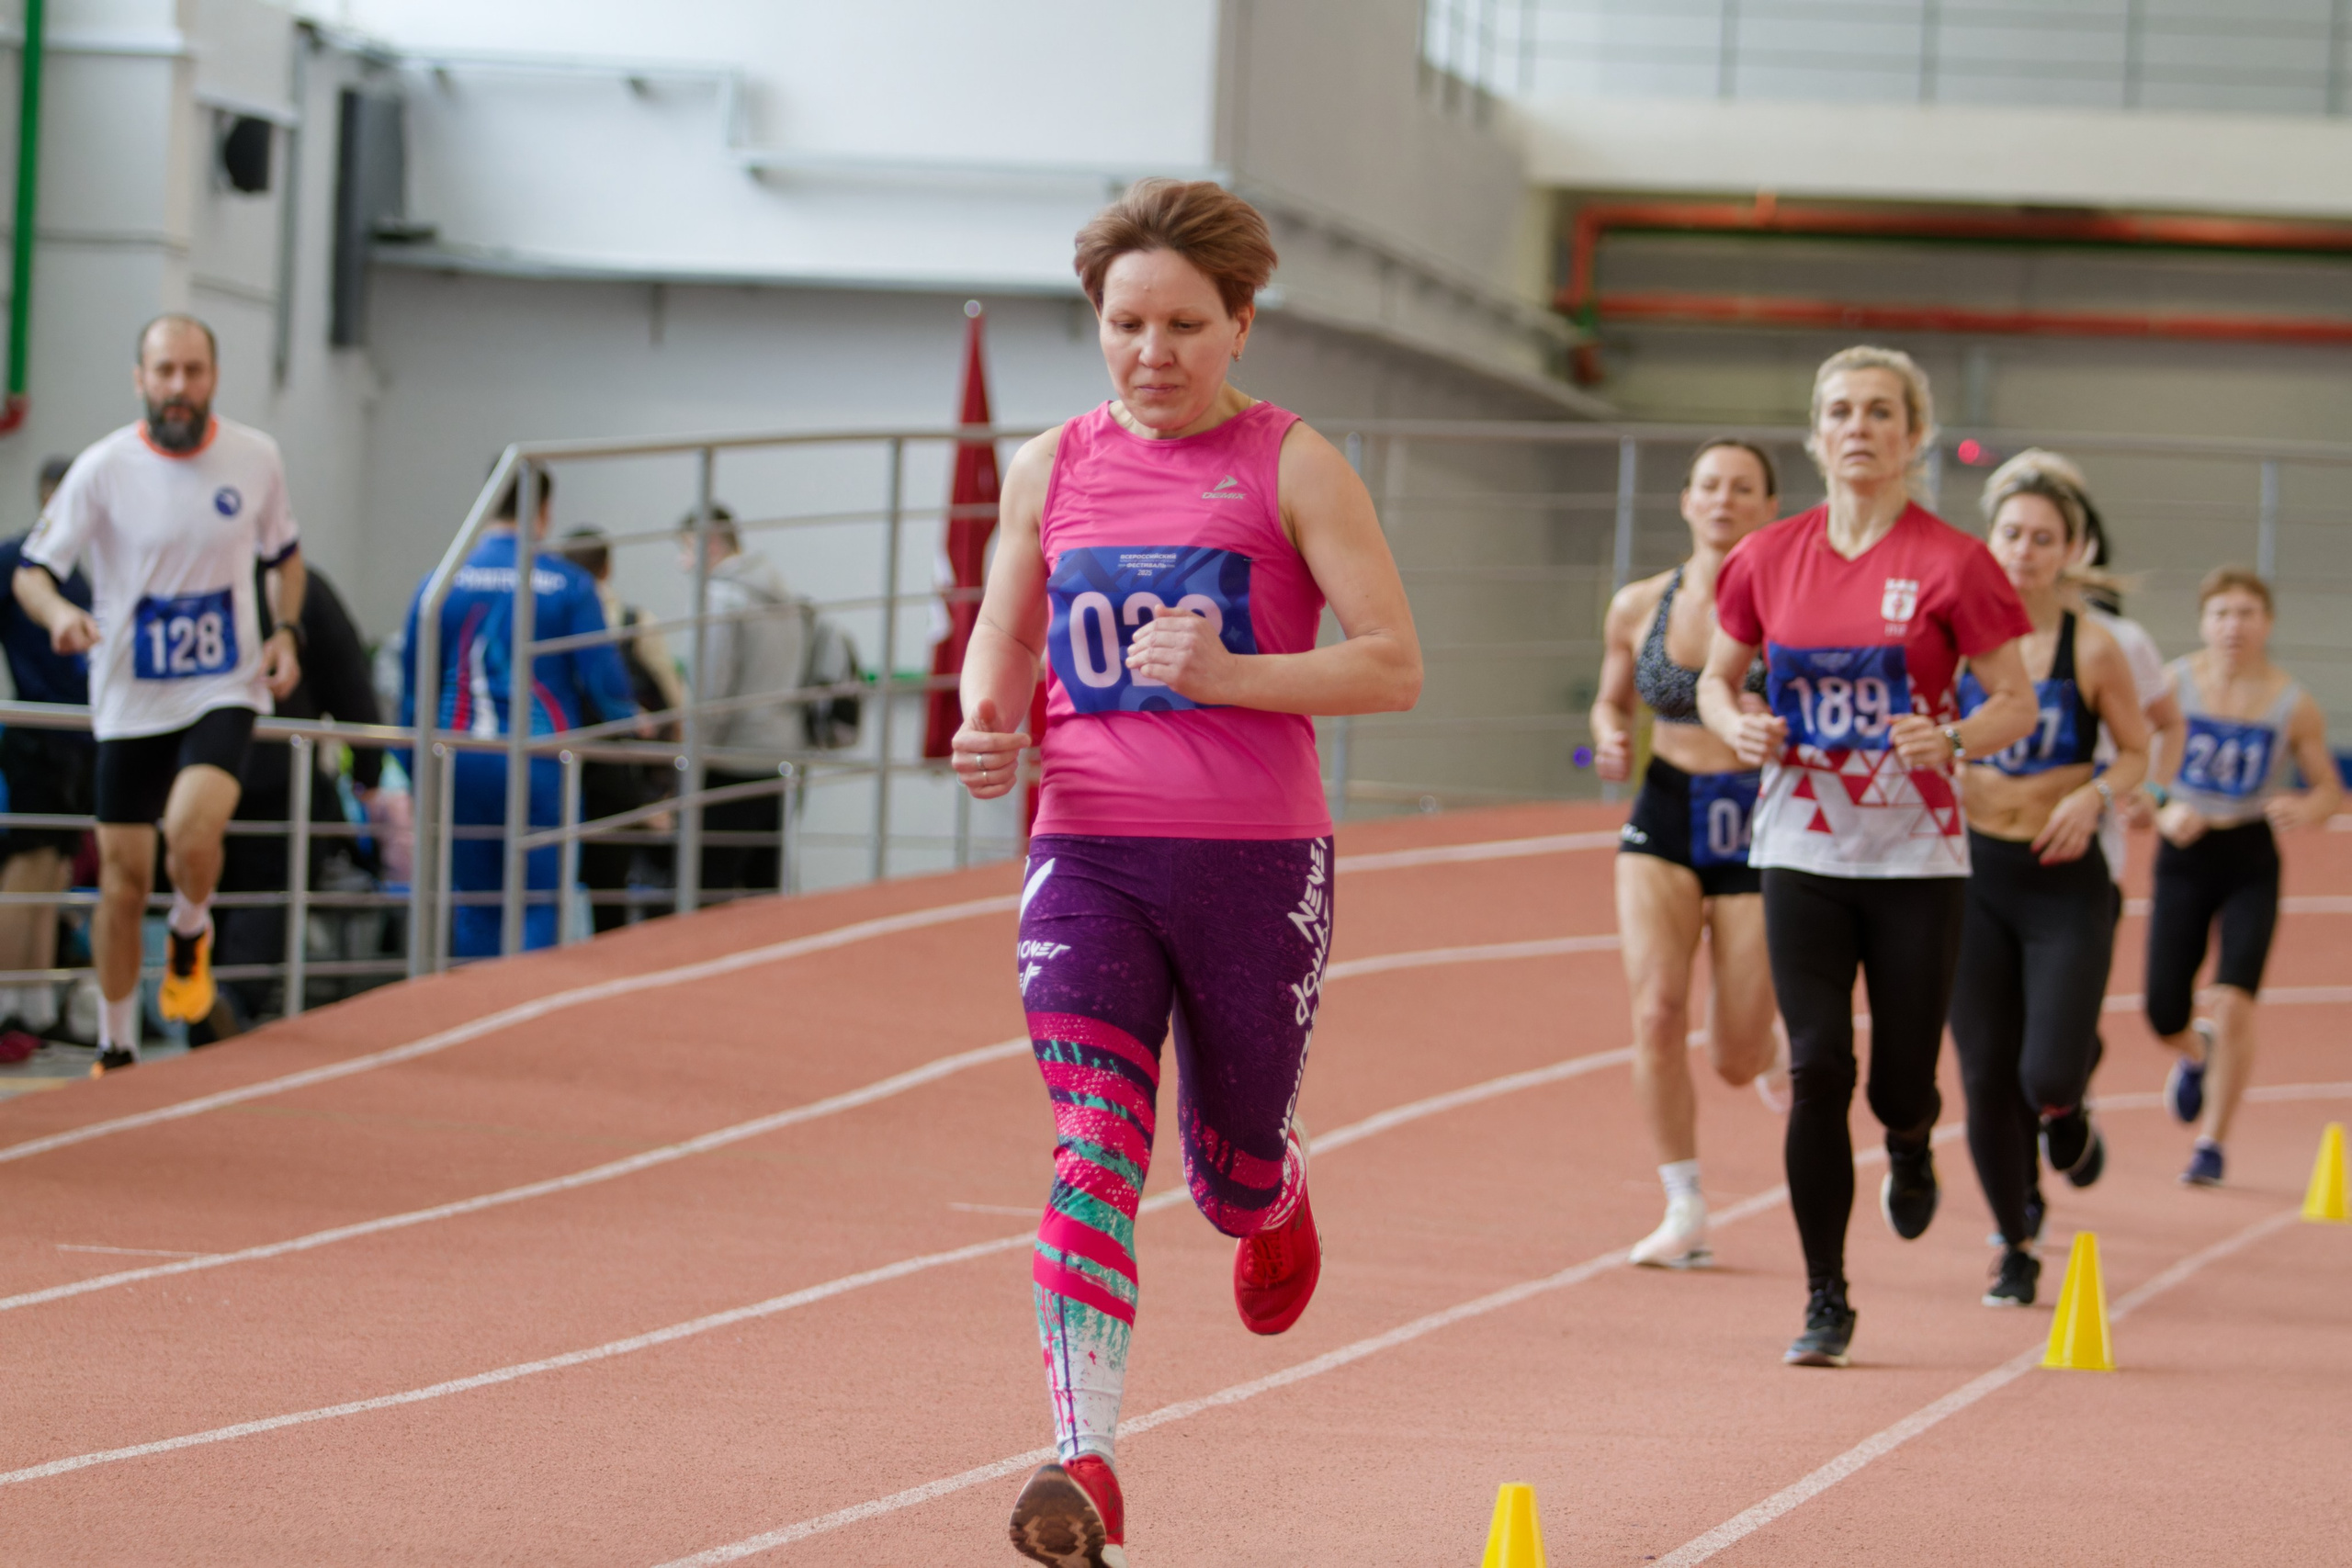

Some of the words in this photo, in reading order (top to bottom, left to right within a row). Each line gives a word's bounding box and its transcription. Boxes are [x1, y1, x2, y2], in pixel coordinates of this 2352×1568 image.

[145, 612, 225, 674] 128
[1786, 676, 1892, 738] 189
[2187, 733, 2264, 789] 241
